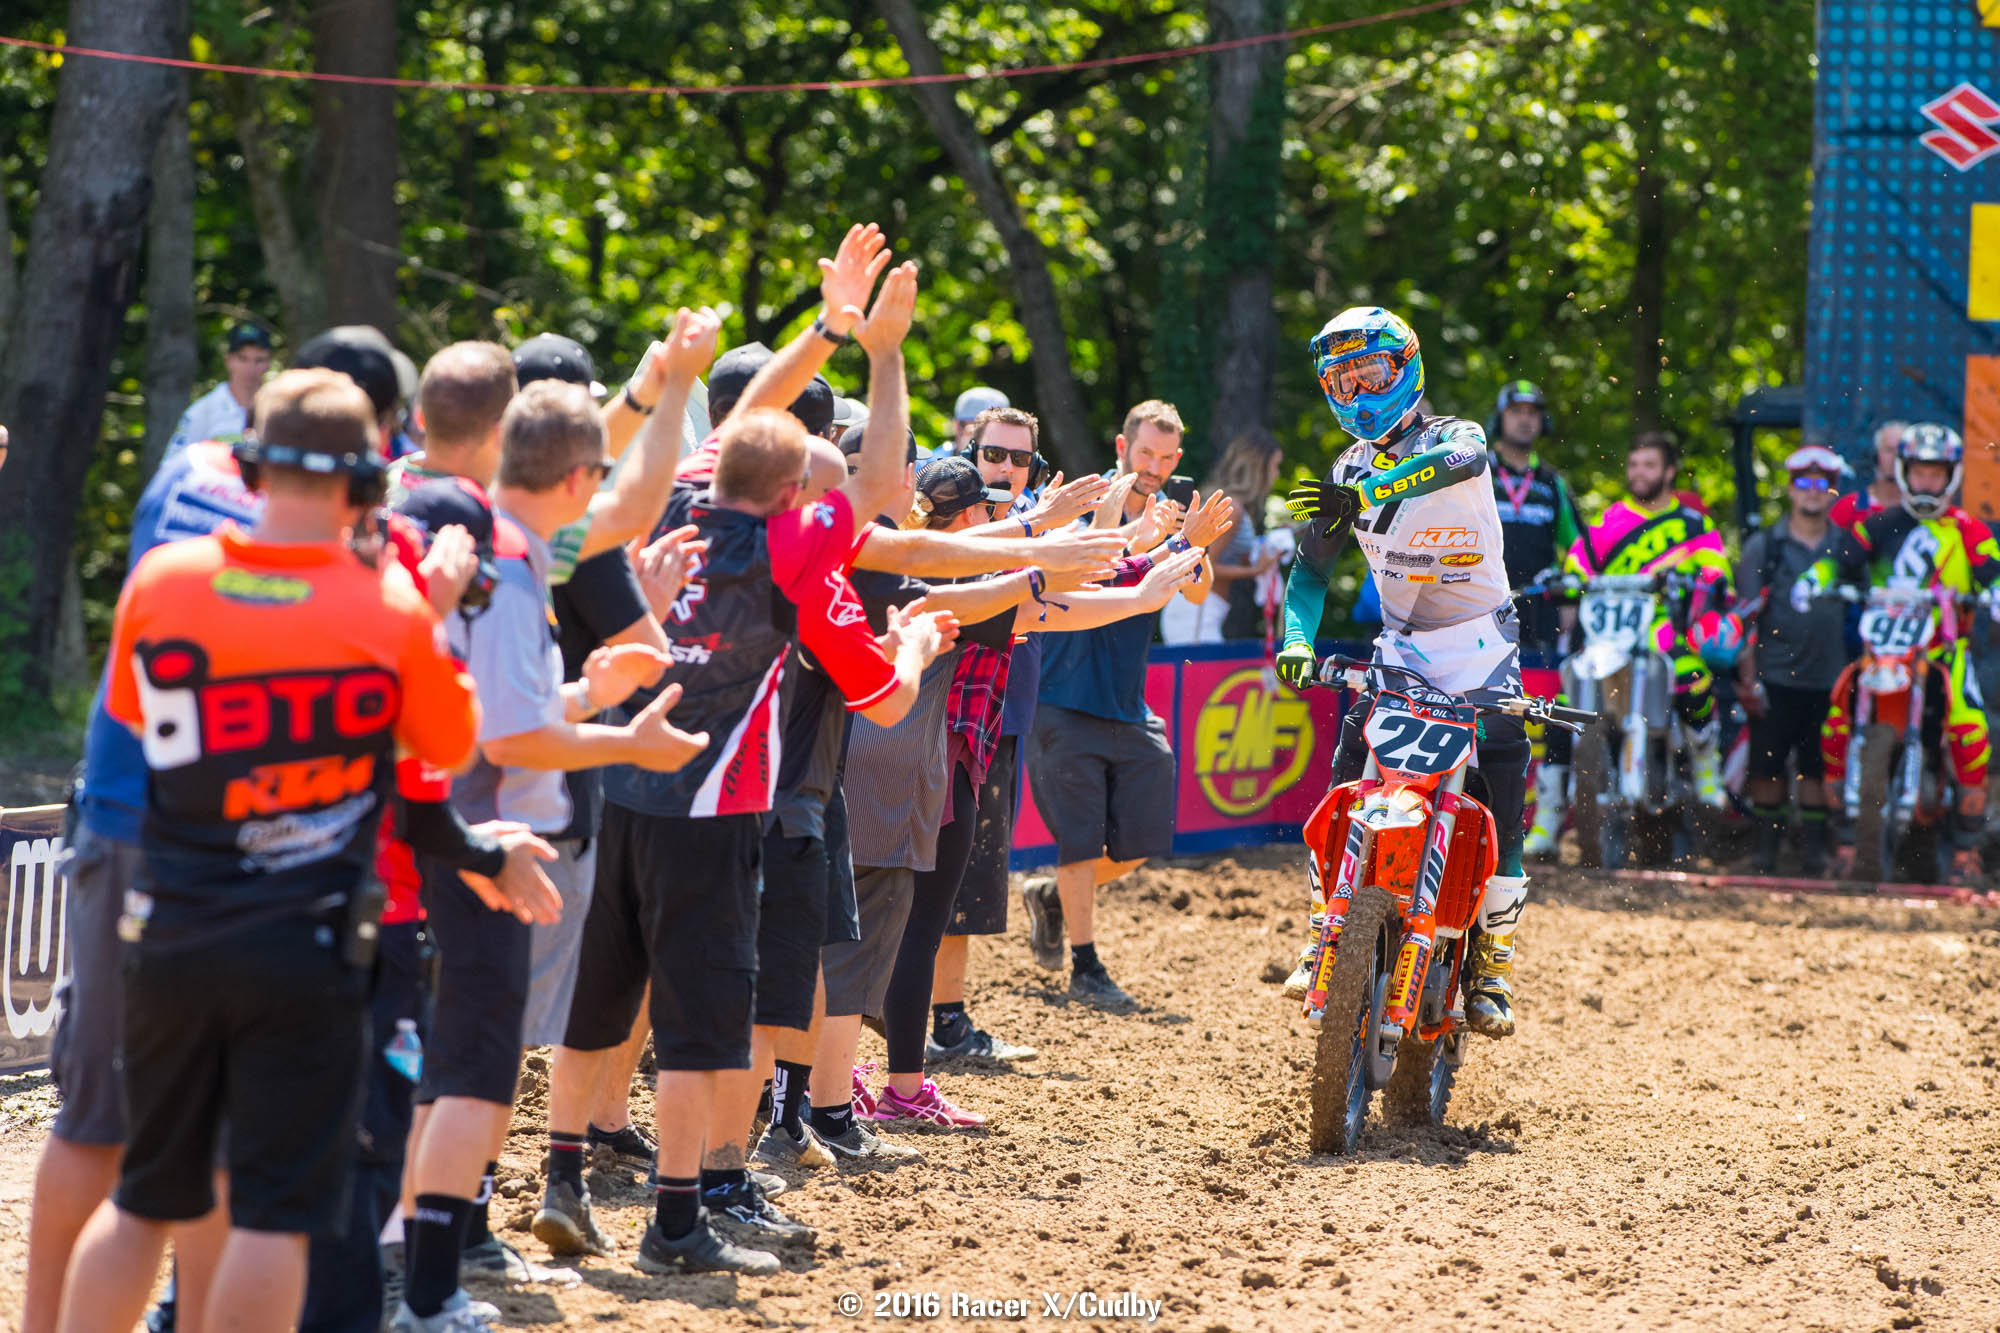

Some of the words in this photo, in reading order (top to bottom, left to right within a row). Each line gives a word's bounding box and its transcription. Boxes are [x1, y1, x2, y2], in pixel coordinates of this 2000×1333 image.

[1408, 527, 1478, 547] KTM
[1592, 602, 1642, 632] 314
[1871, 617, 1928, 646] 99
[1195, 690, 1309, 774] FMF
[1432, 708, 1448, 718] OIL
[1373, 715, 1474, 774] 29
[223, 754, 375, 820] KTM
[1391, 950, 1412, 1000] PIRELLI
